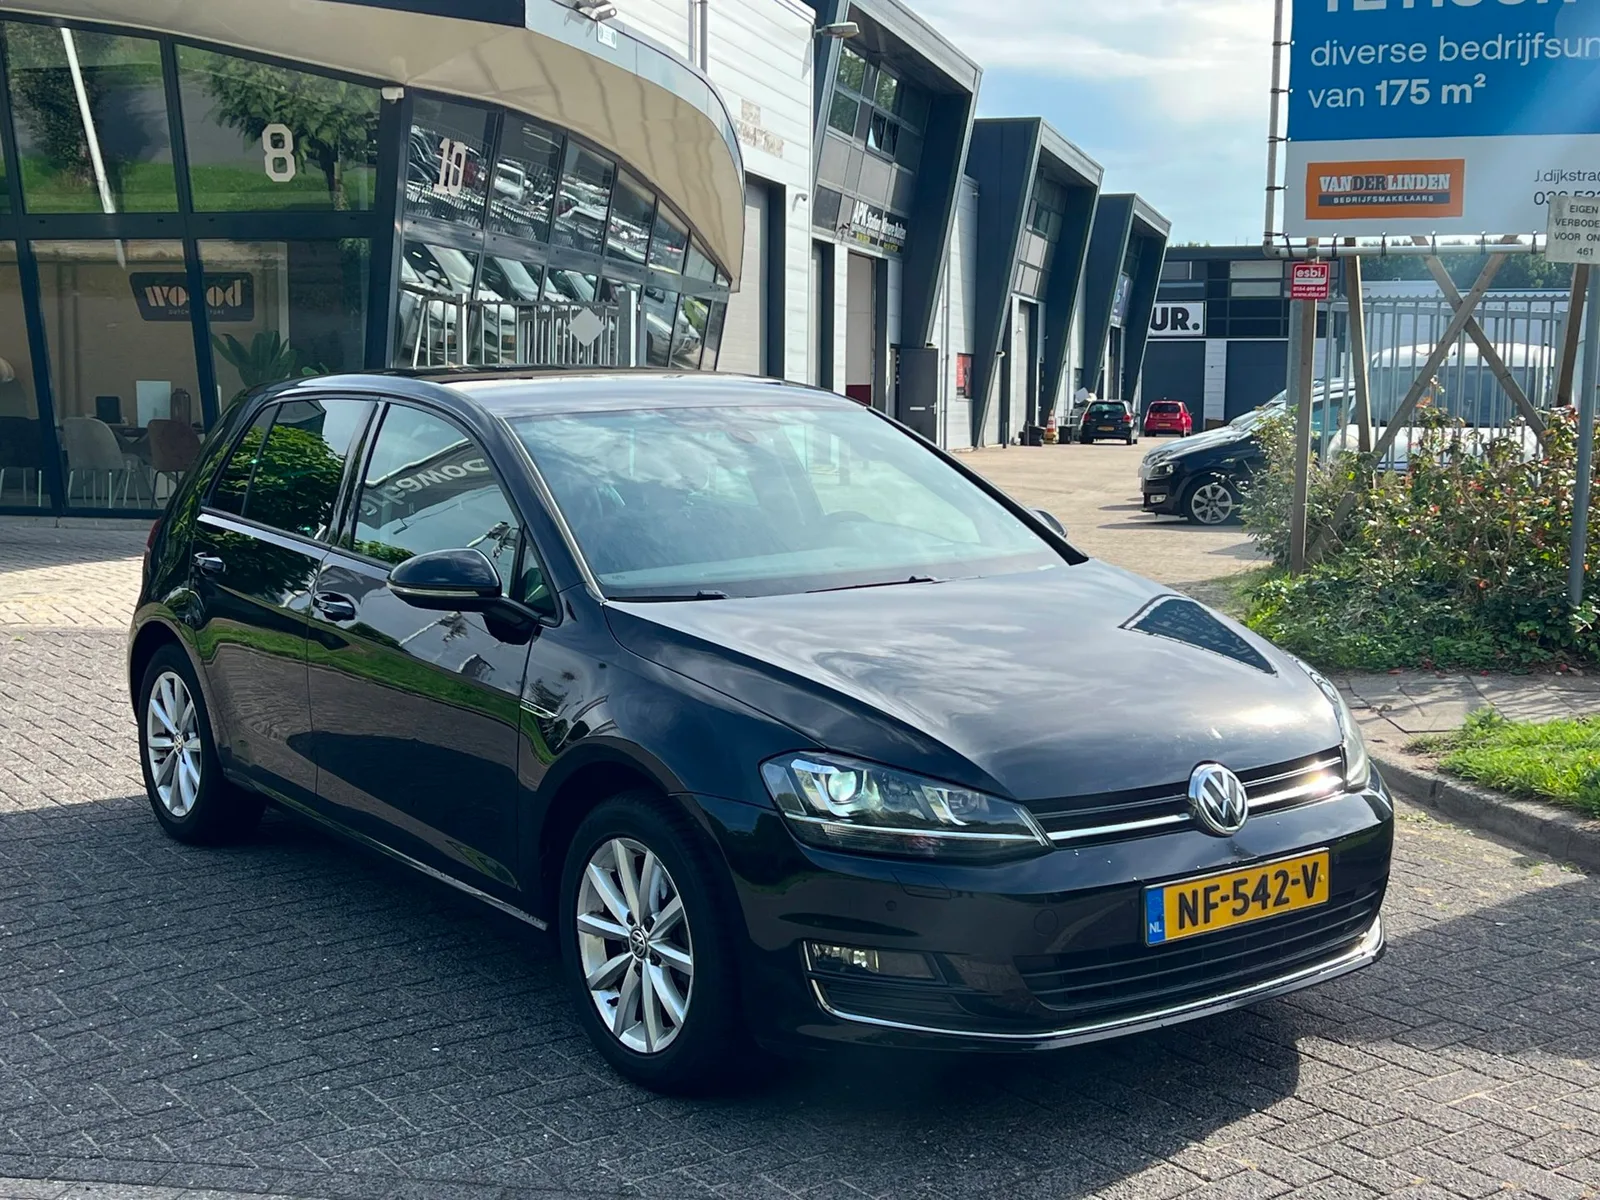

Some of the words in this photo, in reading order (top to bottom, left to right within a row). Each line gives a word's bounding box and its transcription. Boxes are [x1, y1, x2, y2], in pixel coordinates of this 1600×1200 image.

[1310, 39, 1428, 67] diverse
[1307, 86, 1365, 109] van
[1375, 78, 1431, 107] 175
[1441, 72, 1487, 105] m²
[261, 123, 296, 183] 8
[432, 137, 467, 198] 10
[1533, 168, 1600, 185] J.dijkstra
[1333, 194, 1434, 205] BEDRIJFSMAKELAARS
[1569, 204, 1599, 214] EIGEN
[1554, 232, 1582, 241] VOOR
[1576, 247, 1594, 256] 461
[1150, 306, 1200, 332] UR.
[1178, 861, 1320, 930] NF-542-V
[1149, 921, 1163, 934] NL
